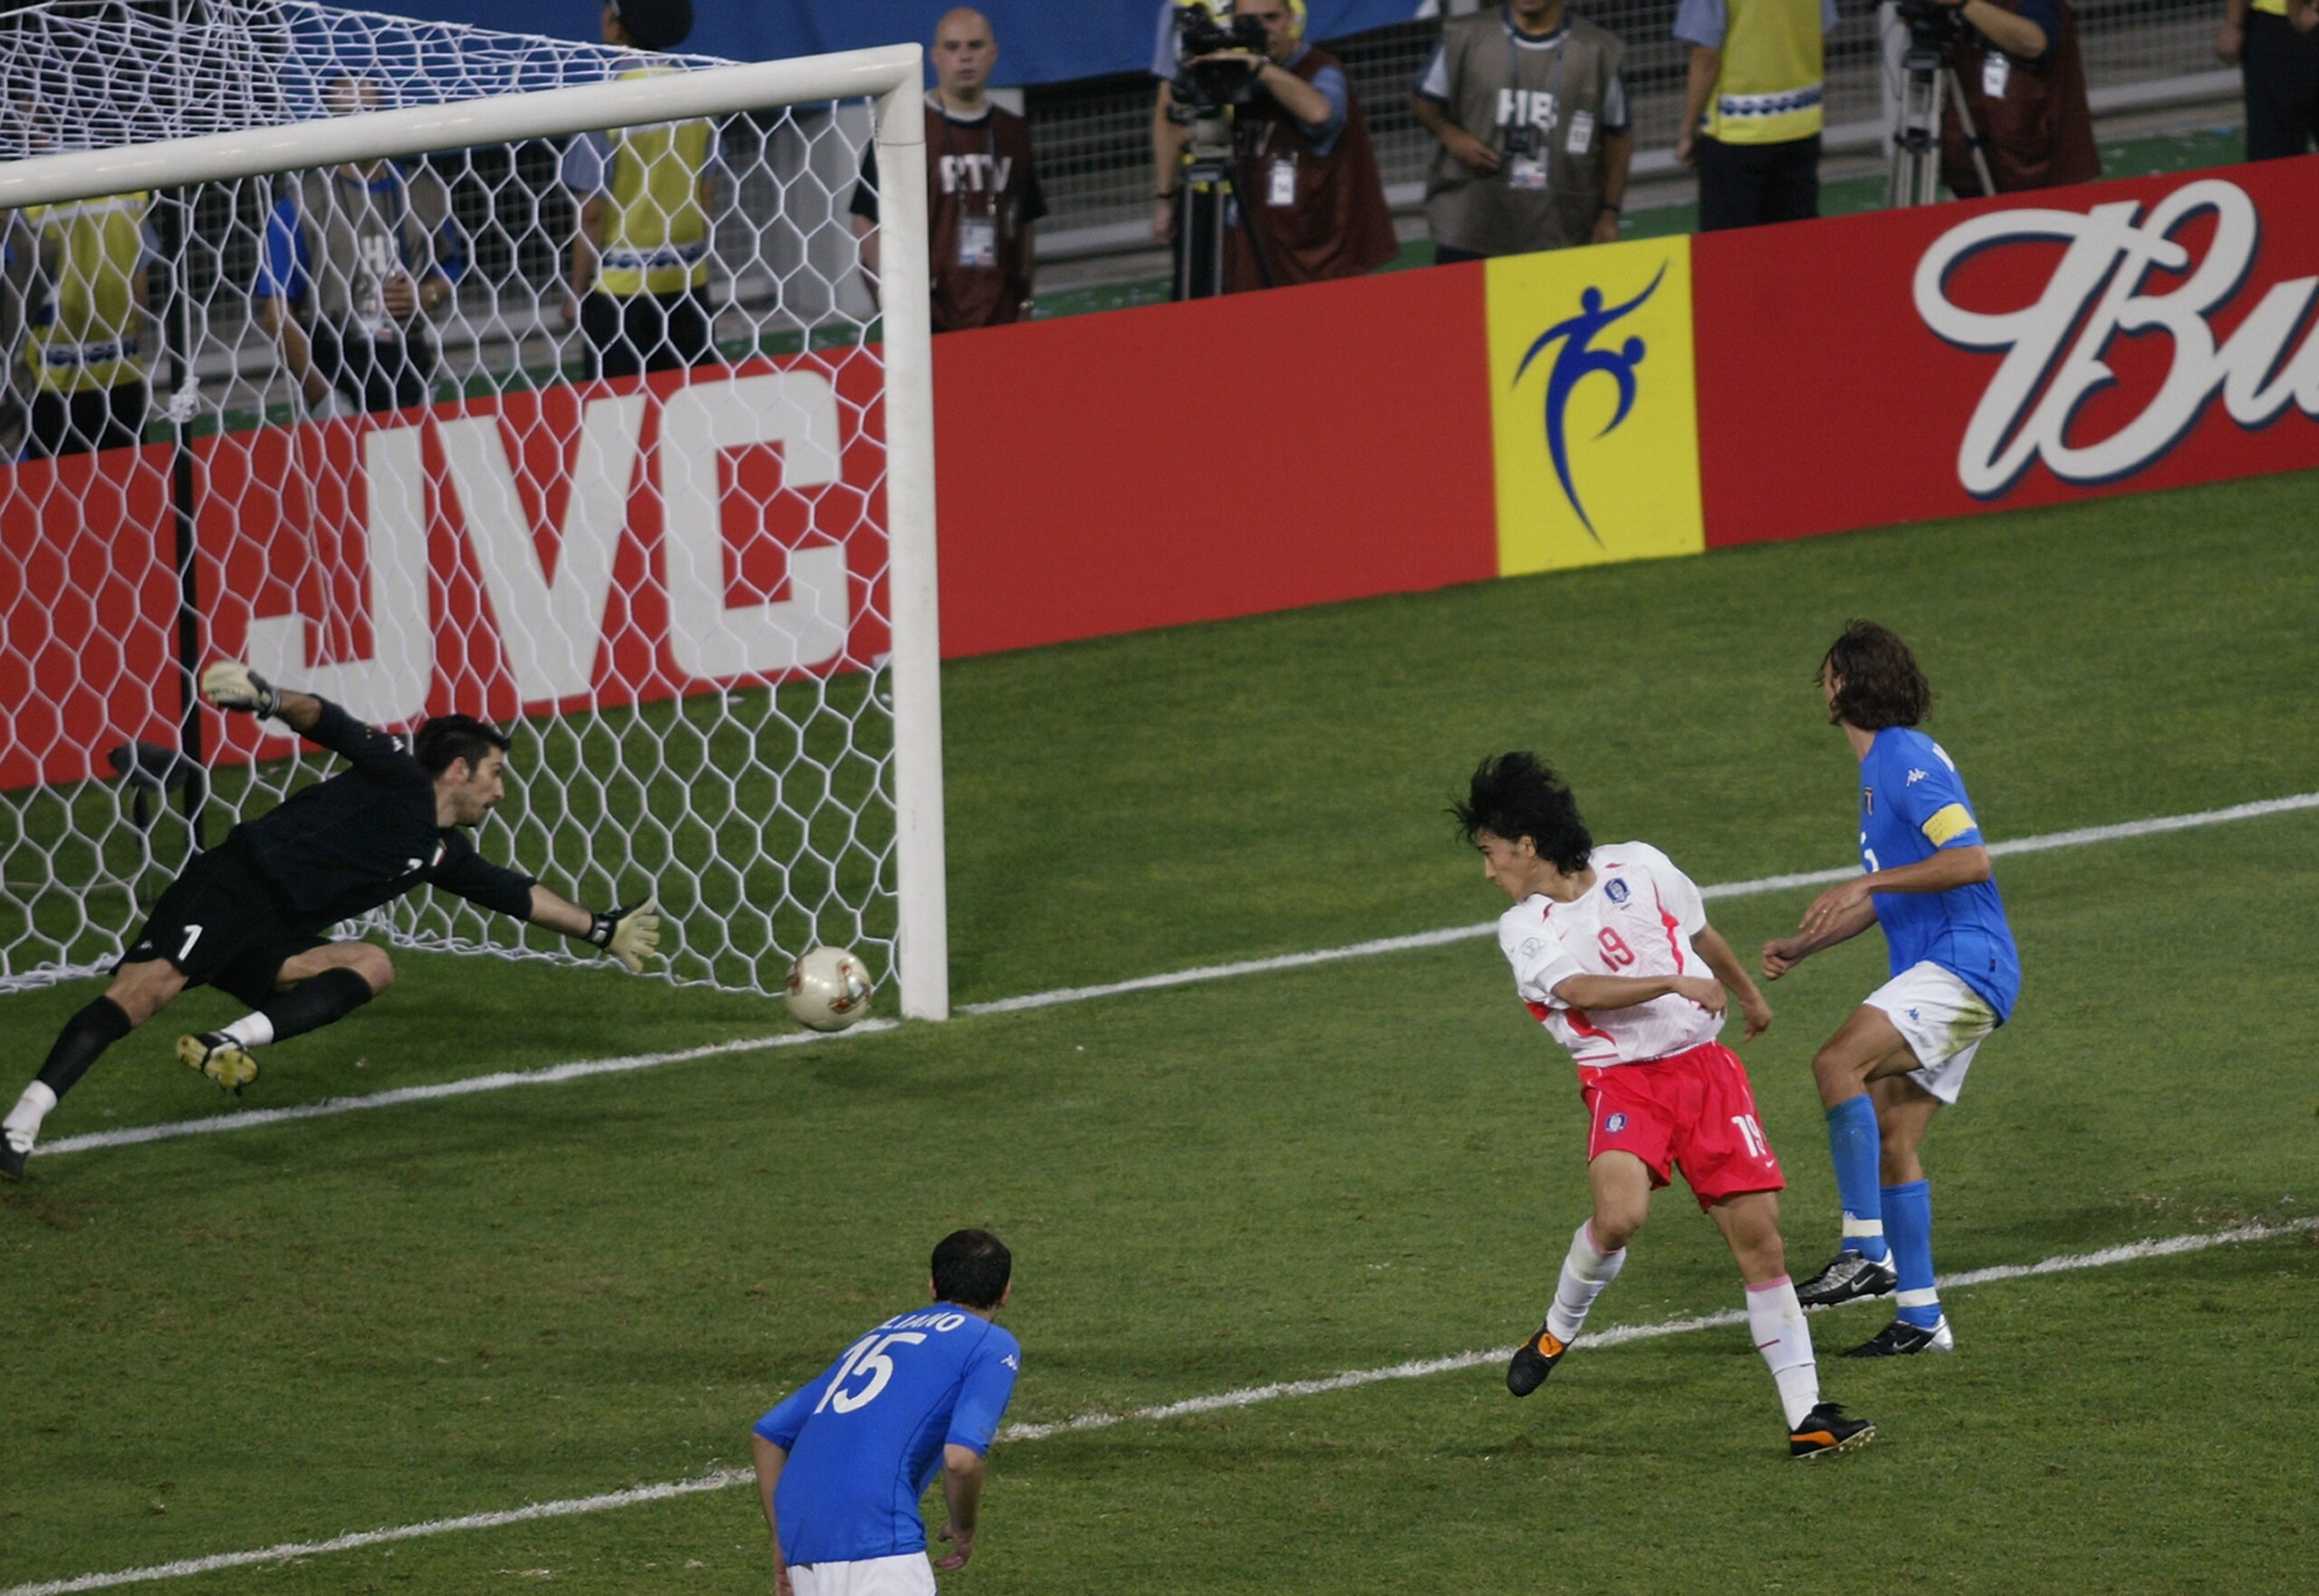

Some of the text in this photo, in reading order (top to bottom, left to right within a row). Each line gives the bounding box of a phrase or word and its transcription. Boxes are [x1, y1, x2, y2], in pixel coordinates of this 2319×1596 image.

[938, 153, 1012, 193] RTV
[247, 369, 850, 736] JVC
[178, 924, 203, 961] 1
[1598, 927, 1635, 973] 19
[1730, 1114, 1766, 1158] 19
[870, 1312, 967, 1332] LIANO
[813, 1332, 928, 1414] 15
